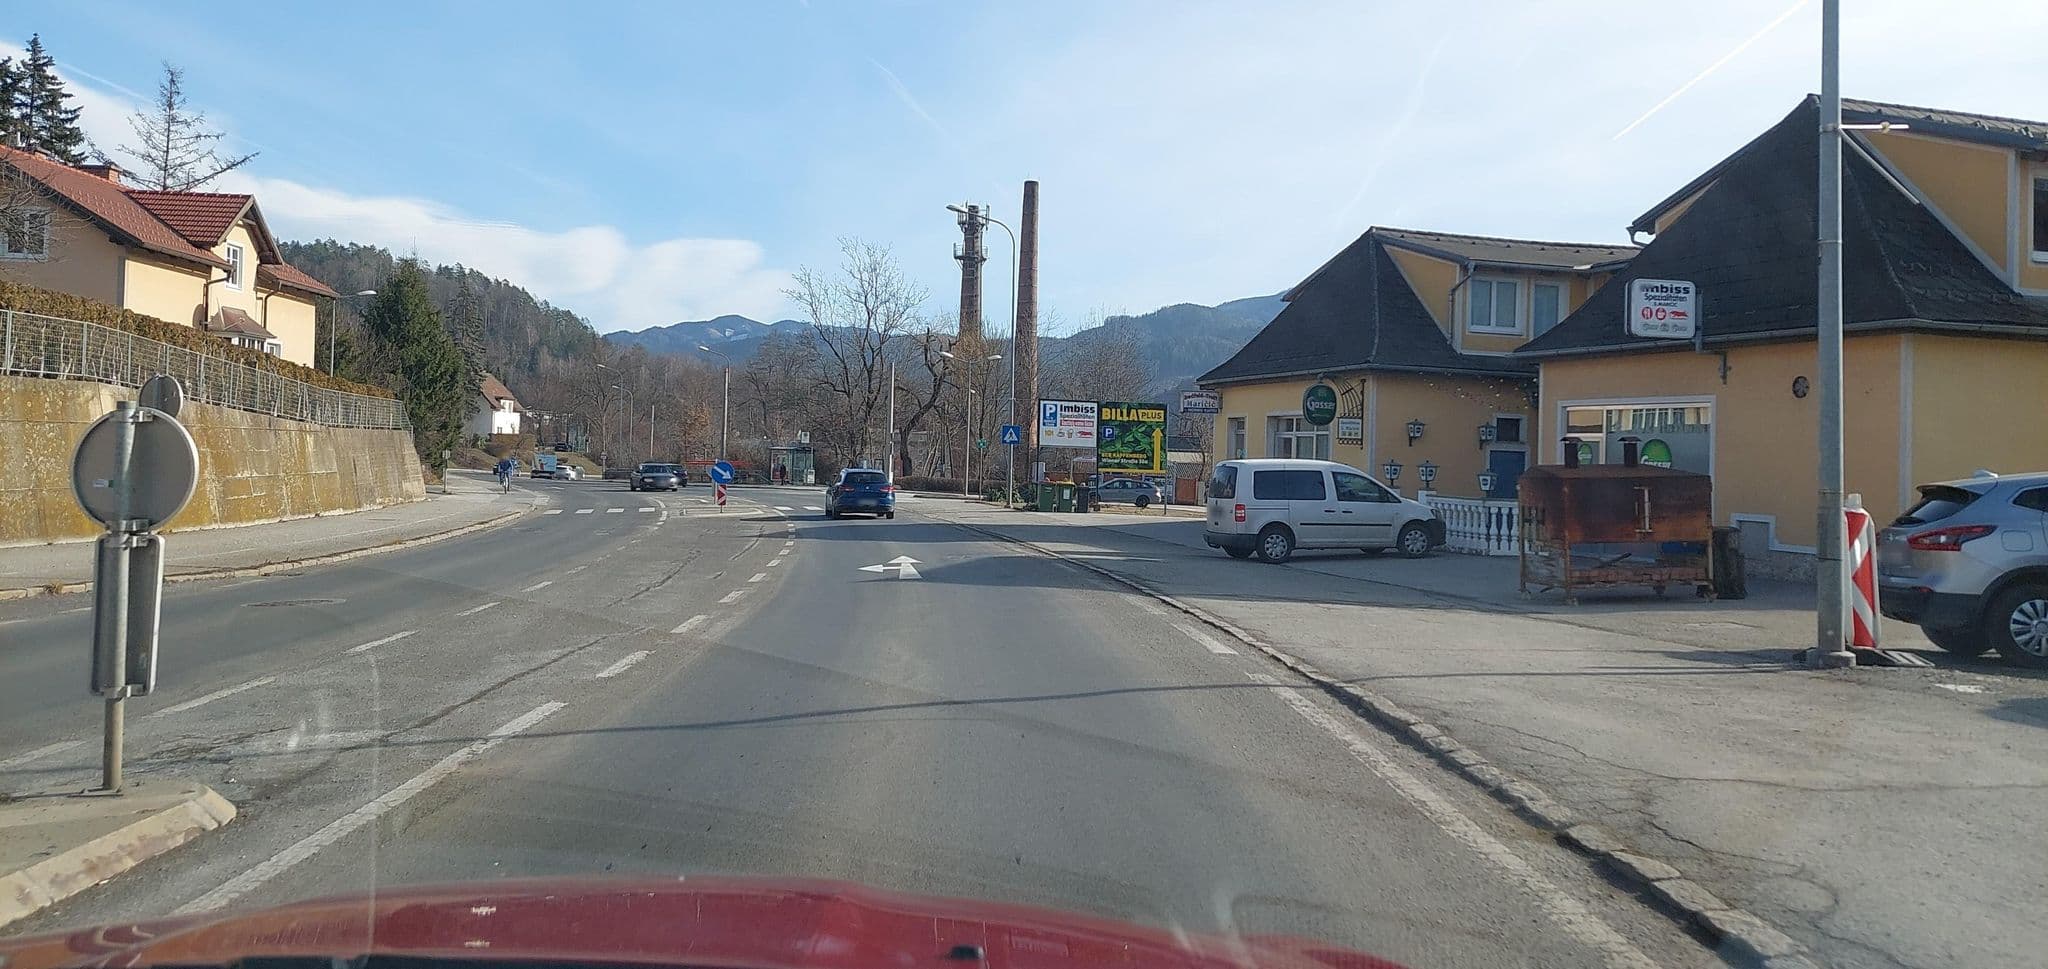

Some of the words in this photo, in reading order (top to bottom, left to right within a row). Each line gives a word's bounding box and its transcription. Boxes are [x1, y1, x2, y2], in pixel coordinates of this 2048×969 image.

[1046, 404, 1056, 417] P
[1060, 404, 1095, 413] Imbiss
[1102, 408, 1138, 421] BILLA
[1141, 411, 1162, 420] PLUS
[1105, 428, 1113, 437] P
